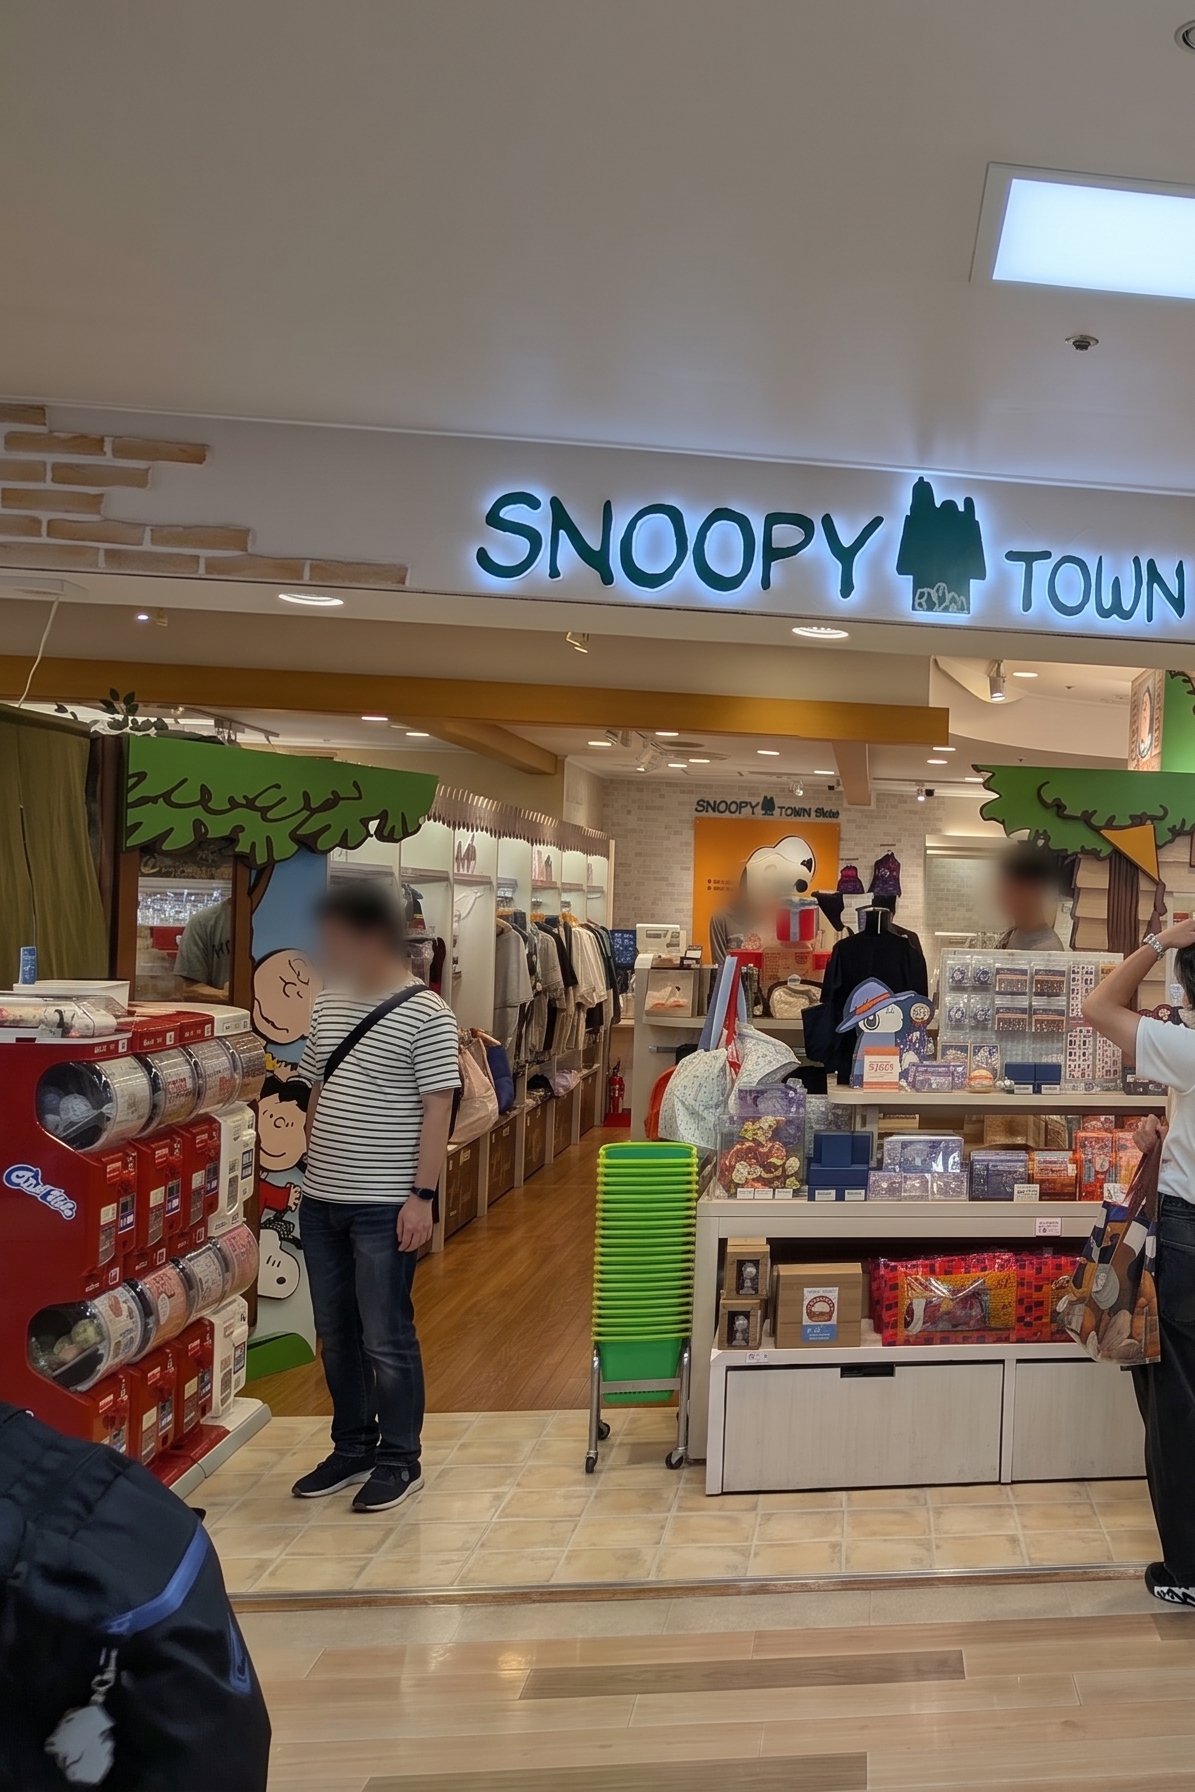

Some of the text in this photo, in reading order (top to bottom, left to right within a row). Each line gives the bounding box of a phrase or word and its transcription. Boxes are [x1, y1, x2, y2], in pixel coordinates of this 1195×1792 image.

[475, 491, 885, 600] SNOOPY
[1004, 550, 1187, 623] TOWN
[694, 798, 761, 816] SNOOPY
[777, 805, 812, 818] TOWN
